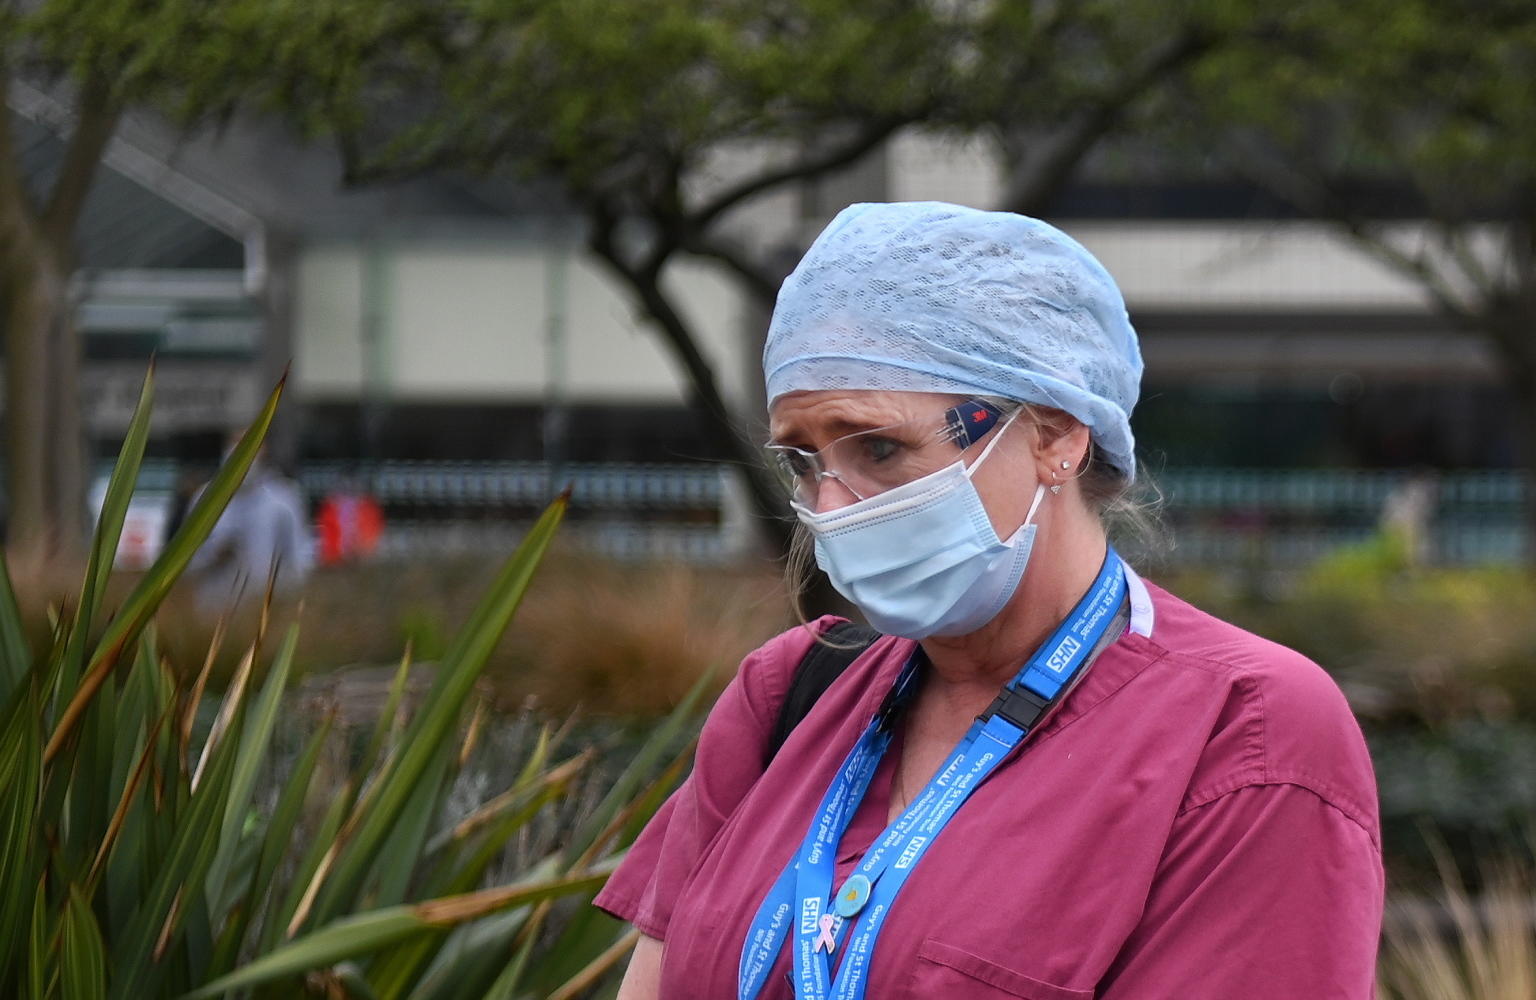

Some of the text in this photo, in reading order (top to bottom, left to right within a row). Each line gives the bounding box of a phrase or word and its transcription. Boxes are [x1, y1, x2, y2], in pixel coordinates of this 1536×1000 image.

[972, 410, 988, 422] 3M
[1048, 637, 1079, 671] NHS
[971, 752, 994, 772] Guy's
[958, 773, 973, 789] and
[950, 789, 961, 798] St
[822, 815, 831, 825] St
[817, 824, 828, 842] and
[808, 842, 822, 864] Guy's
[863, 848, 884, 871] Guy's
[883, 830, 898, 847] and
[896, 821, 907, 830] St
[896, 837, 926, 868] NHS
[771, 903, 788, 928] Guy's
[802, 898, 820, 933] NHS
[867, 904, 883, 931] Guy's
[763, 929, 775, 950] and
[861, 931, 870, 953] and
[758, 949, 768, 960] St
[801, 940, 812, 980] Thomas'
[854, 955, 864, 966] St
[803, 982, 813, 994] St
